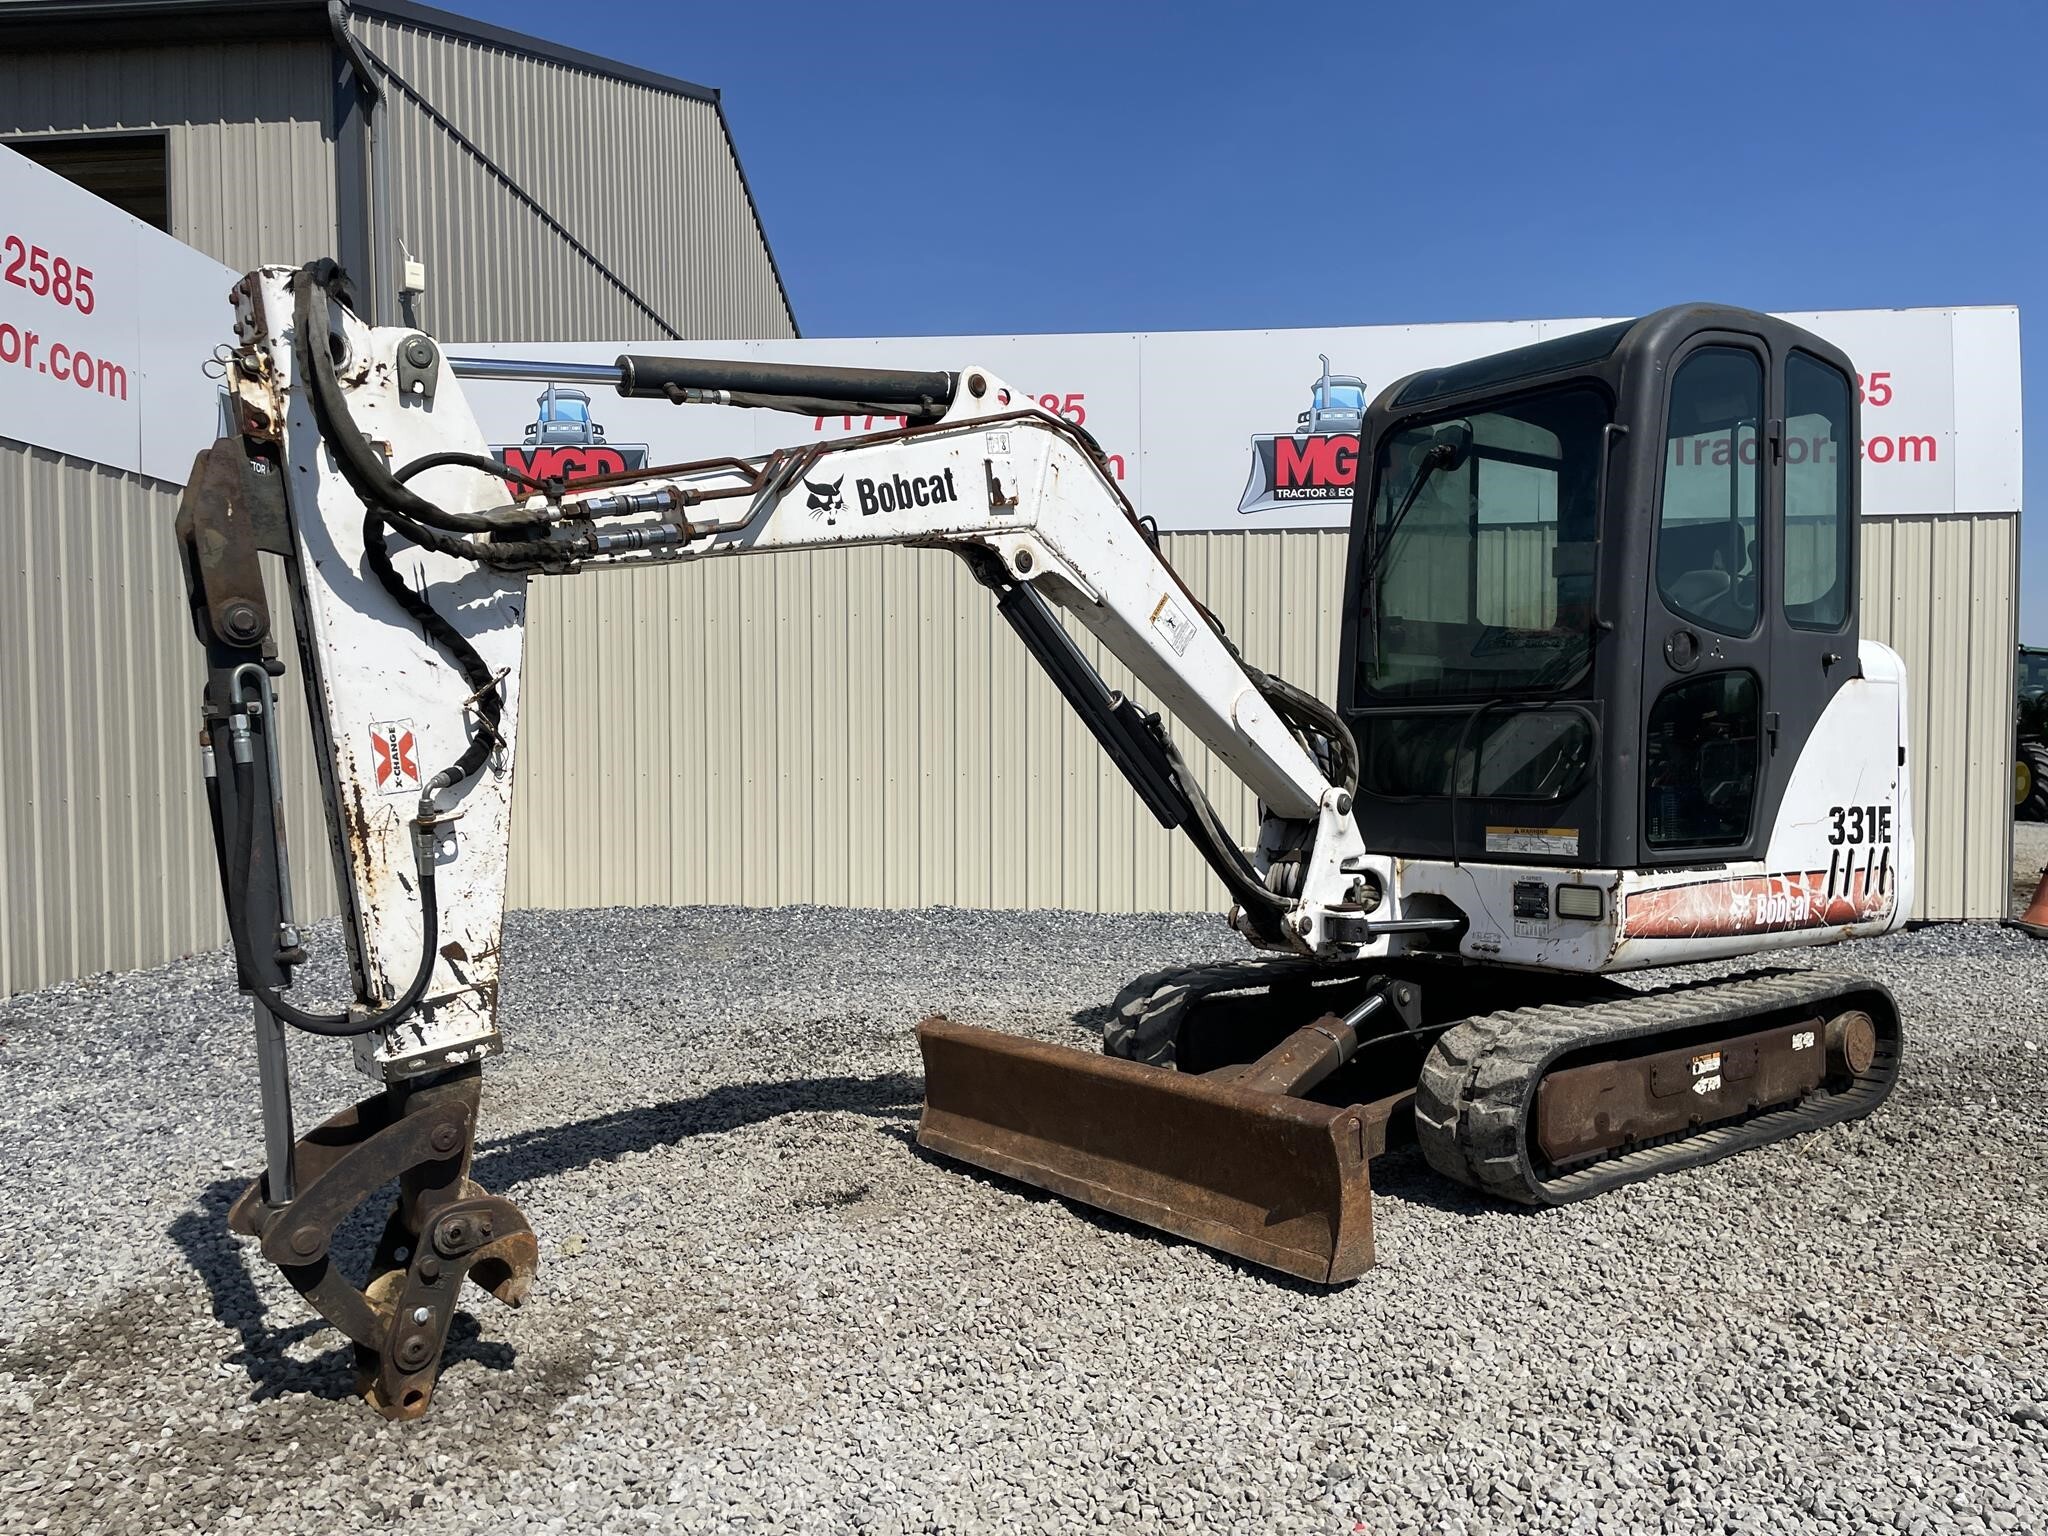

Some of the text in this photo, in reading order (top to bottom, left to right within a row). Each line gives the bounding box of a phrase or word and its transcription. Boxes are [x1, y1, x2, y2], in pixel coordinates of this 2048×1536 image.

[0, 235, 94, 315] 2585
[250, 461, 266, 475] TOR
[1275, 435, 1360, 487] MG
[856, 467, 958, 516] Bobcat
[1276, 488, 1355, 498] TRACTOR & EQ
[388, 727, 403, 788] X-CHANGE
[1828, 806, 1892, 845] 331E
[1755, 893, 1810, 924] Bobcat
